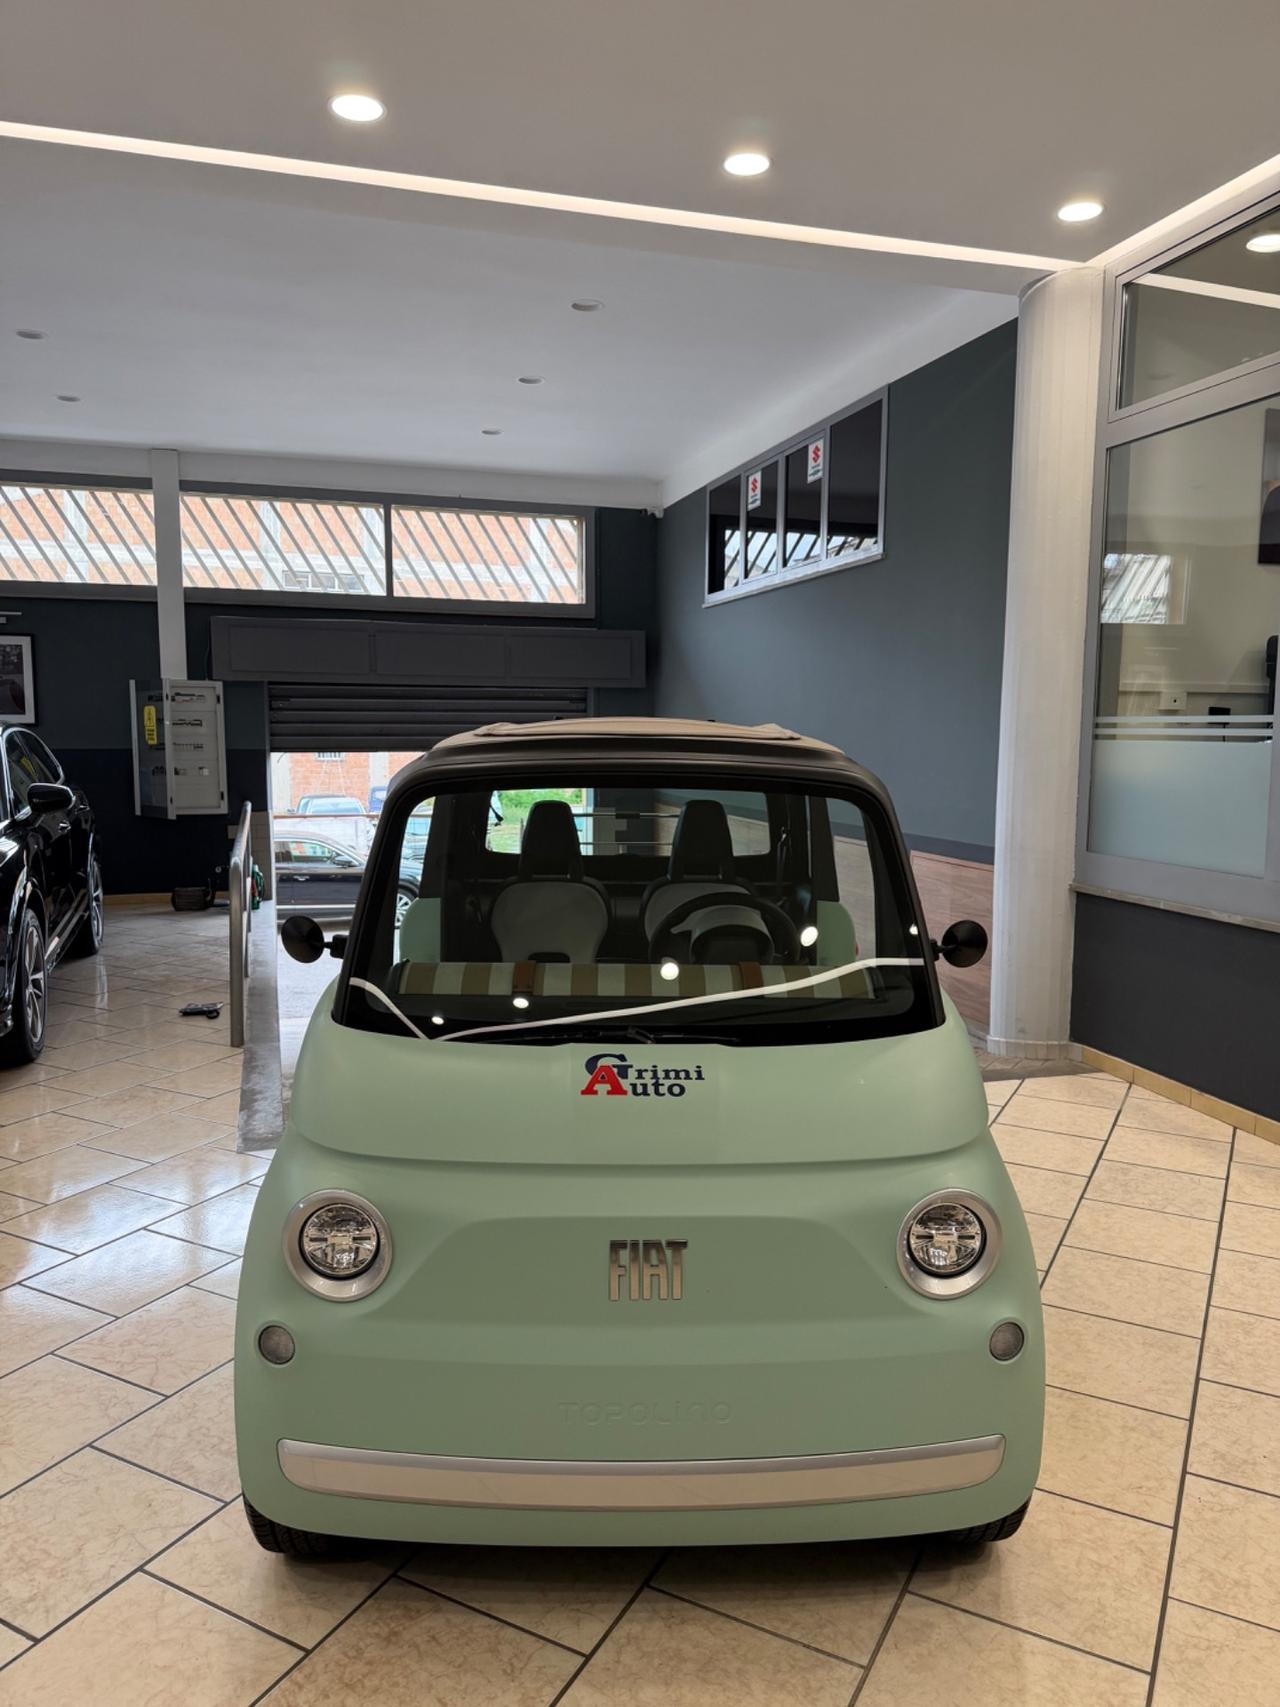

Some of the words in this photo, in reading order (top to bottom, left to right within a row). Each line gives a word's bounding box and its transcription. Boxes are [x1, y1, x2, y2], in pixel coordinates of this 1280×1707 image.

[580, 1065, 686, 1097] Auto
[585, 1053, 706, 1081] Grimi
[609, 1239, 688, 1301] FIAT
